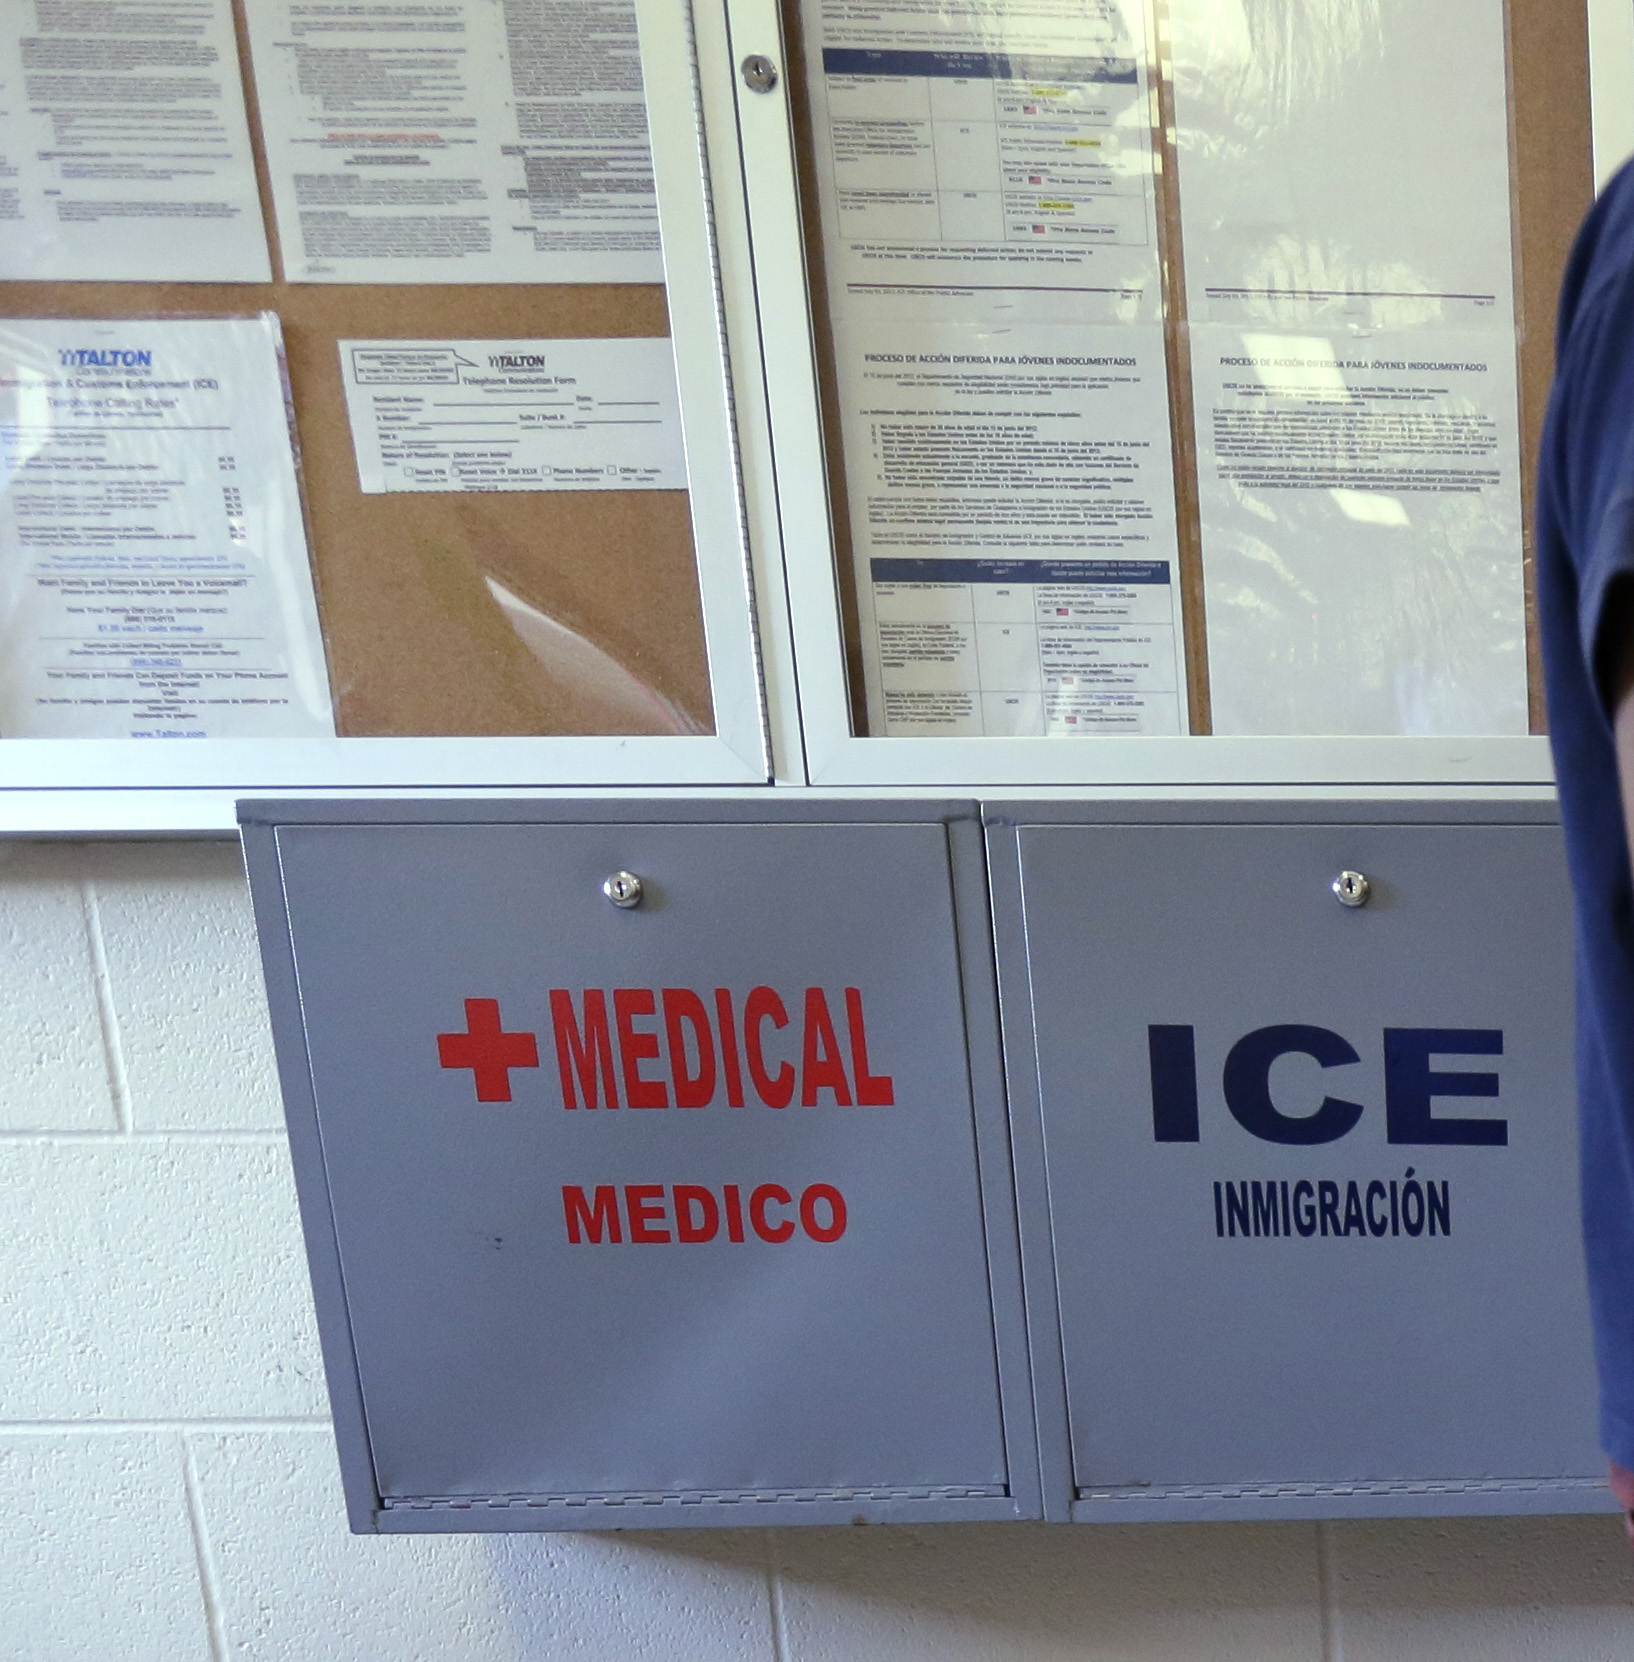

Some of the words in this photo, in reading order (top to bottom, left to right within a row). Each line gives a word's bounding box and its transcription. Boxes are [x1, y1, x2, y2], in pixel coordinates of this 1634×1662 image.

[75, 350, 152, 366] TALTON
[501, 355, 545, 367] TALTON
[864, 354, 903, 363] PROCESO
[905, 355, 916, 364] DE
[918, 354, 950, 364] ACCIÓN
[952, 355, 991, 364] DIFERIDA
[993, 356, 1016, 365] PARA
[1017, 355, 1055, 365] JÓVENES
[1056, 357, 1137, 366] INDOCUMENTADOS
[1219, 357, 1258, 366] PROCESO
[1260, 358, 1272, 367] DE
[1346, 360, 1369, 369] PARA
[1370, 359, 1407, 369] JÓVENES
[1408, 361, 1487, 370] INDOCUMENTADOS
[463, 377, 506, 386] Telephone
[508, 377, 553, 385] Resolution
[554, 377, 576, 385] Form
[549, 985, 894, 1111] MEDICAL
[1147, 1023, 1509, 1147] ICE
[1213, 1166, 1452, 1240] INMIGRACIÓN
[562, 1181, 849, 1246] MEDICO
